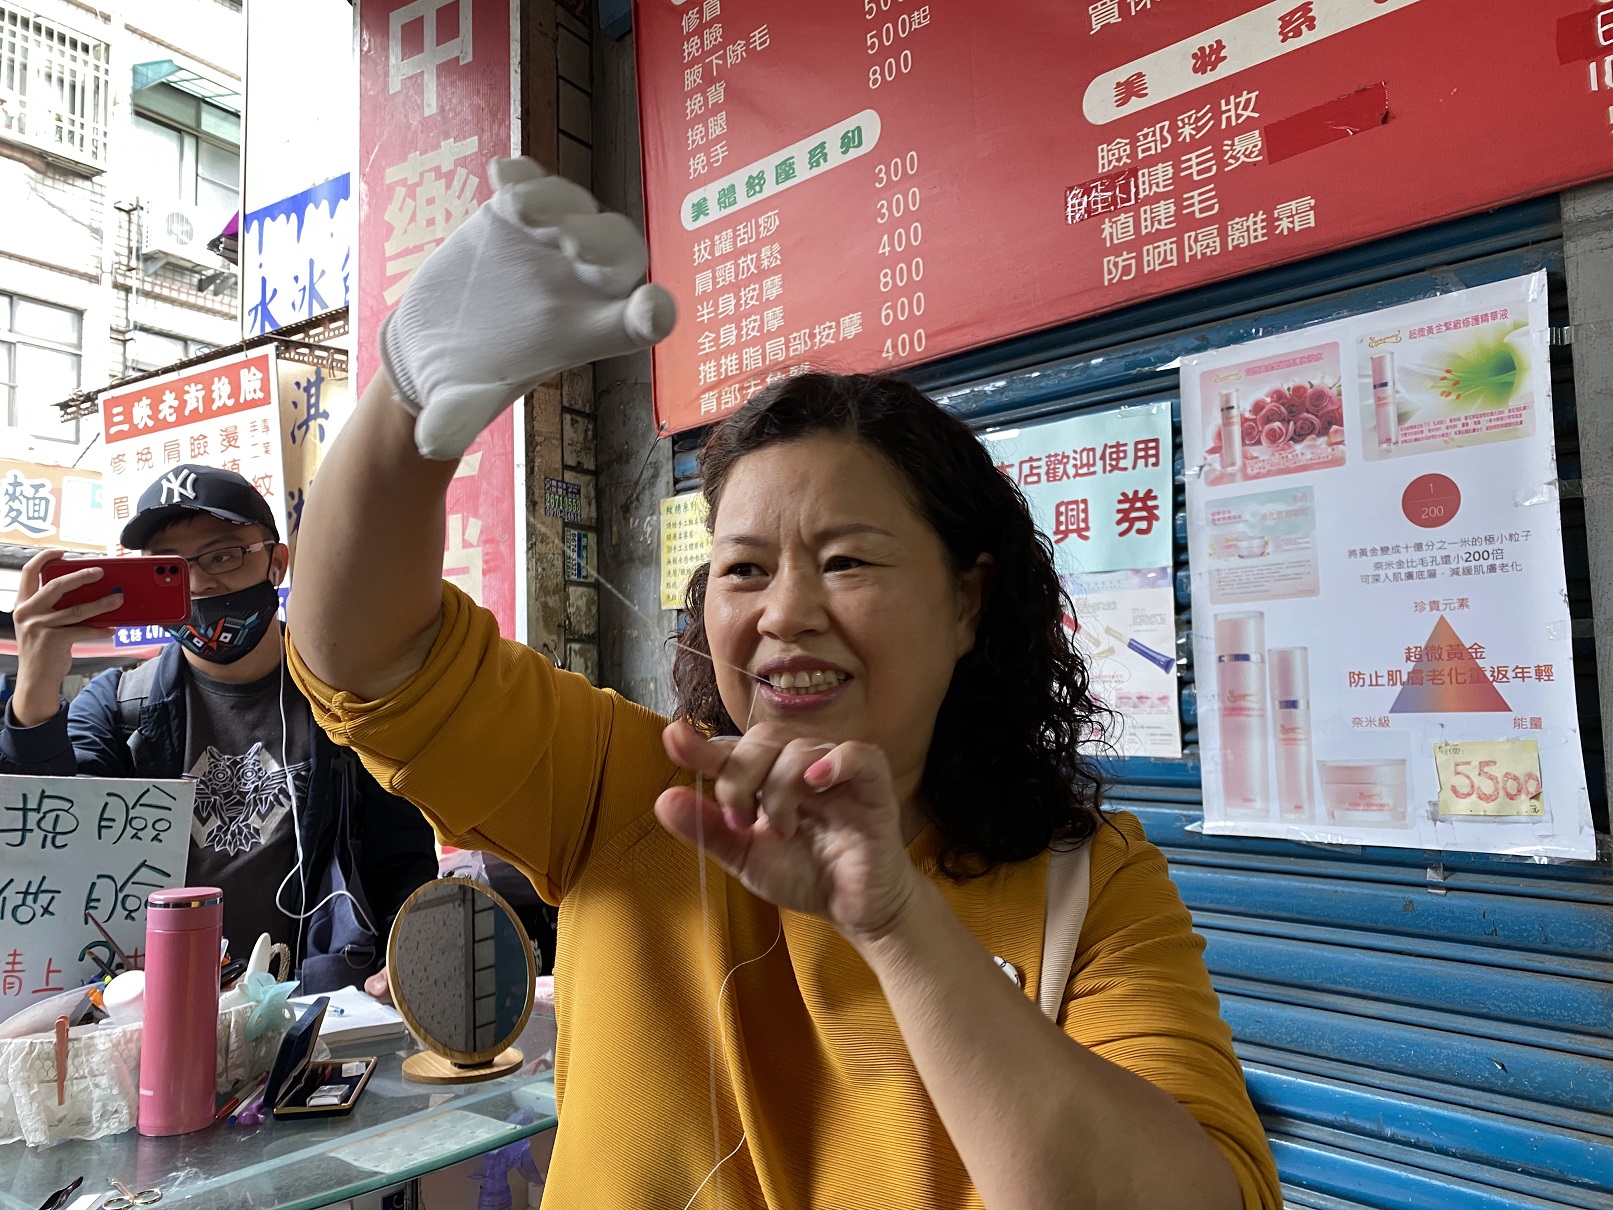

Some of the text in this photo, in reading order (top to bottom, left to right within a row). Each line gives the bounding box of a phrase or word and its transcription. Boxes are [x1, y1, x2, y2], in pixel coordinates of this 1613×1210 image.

[681, 0, 721, 35] 修眉
[866, 5, 930, 54] 500起
[682, 23, 723, 63] 挽臉
[684, 24, 771, 92] 腋下除毛
[868, 49, 912, 89] 800
[685, 81, 726, 120] 挽背
[687, 111, 727, 151] 挽腿
[1097, 90, 1260, 173] 臉部彩妝
[689, 141, 729, 180] 挽手
[691, 125, 863, 220] 美體舒壓系列
[874, 151, 918, 188] 300
[876, 187, 920, 224] 300
[1101, 184, 1220, 248] 植睫毛
[692, 209, 780, 266] 拔罐刮痧
[878, 222, 922, 257] 400
[1103, 196, 1316, 286] 防晒隔離霜
[694, 242, 781, 296] 肩頸放鬆
[879, 257, 924, 292] 800
[696, 273, 783, 324] 半身按摩
[880, 292, 925, 326] 600
[697, 306, 784, 356] 全身按摩
[699, 312, 863, 386] 推推脂局部按摩
[881, 328, 926, 361] 400
[4, 474, 50, 533] 麵
[1428, 483, 1434, 494] 1
[1421, 505, 1444, 519] 200
[1373, 549, 1504, 571] 奈米金比毛孔還小200倍
[1413, 597, 1470, 613] 珍貴元素
[1404, 642, 1486, 663] 超微黃金
[1349, 664, 1555, 688] 防止肌膚老化重返年輕
[1351, 716, 1391, 729] 奈米級
[1513, 716, 1543, 730] 能量
[1450, 759, 1542, 804] 5500
